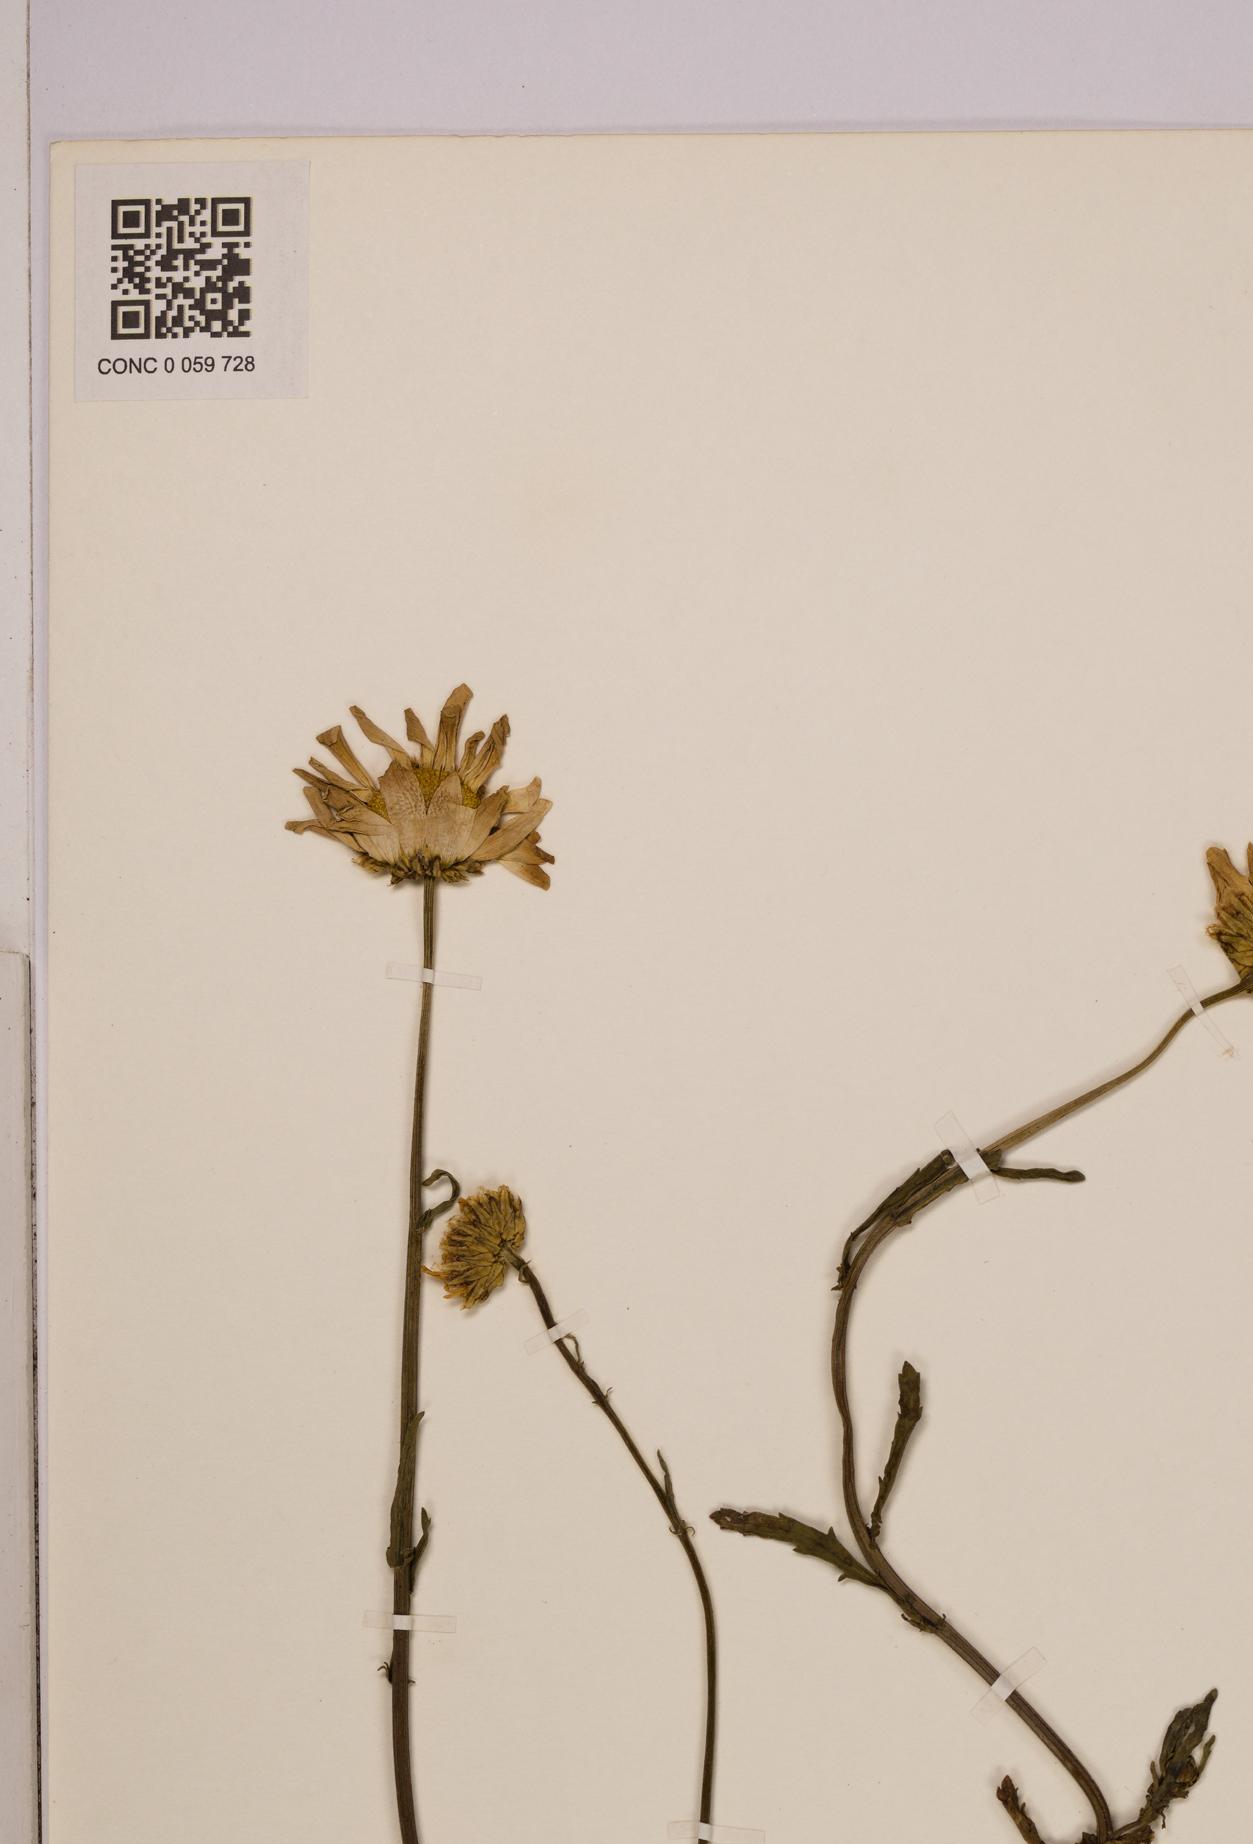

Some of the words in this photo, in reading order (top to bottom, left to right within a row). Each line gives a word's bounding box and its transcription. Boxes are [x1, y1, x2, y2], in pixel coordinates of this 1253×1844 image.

[98, 357, 157, 375] CONC
[165, 357, 174, 373] 0
[182, 356, 215, 373] 059
[222, 356, 255, 372] 728
